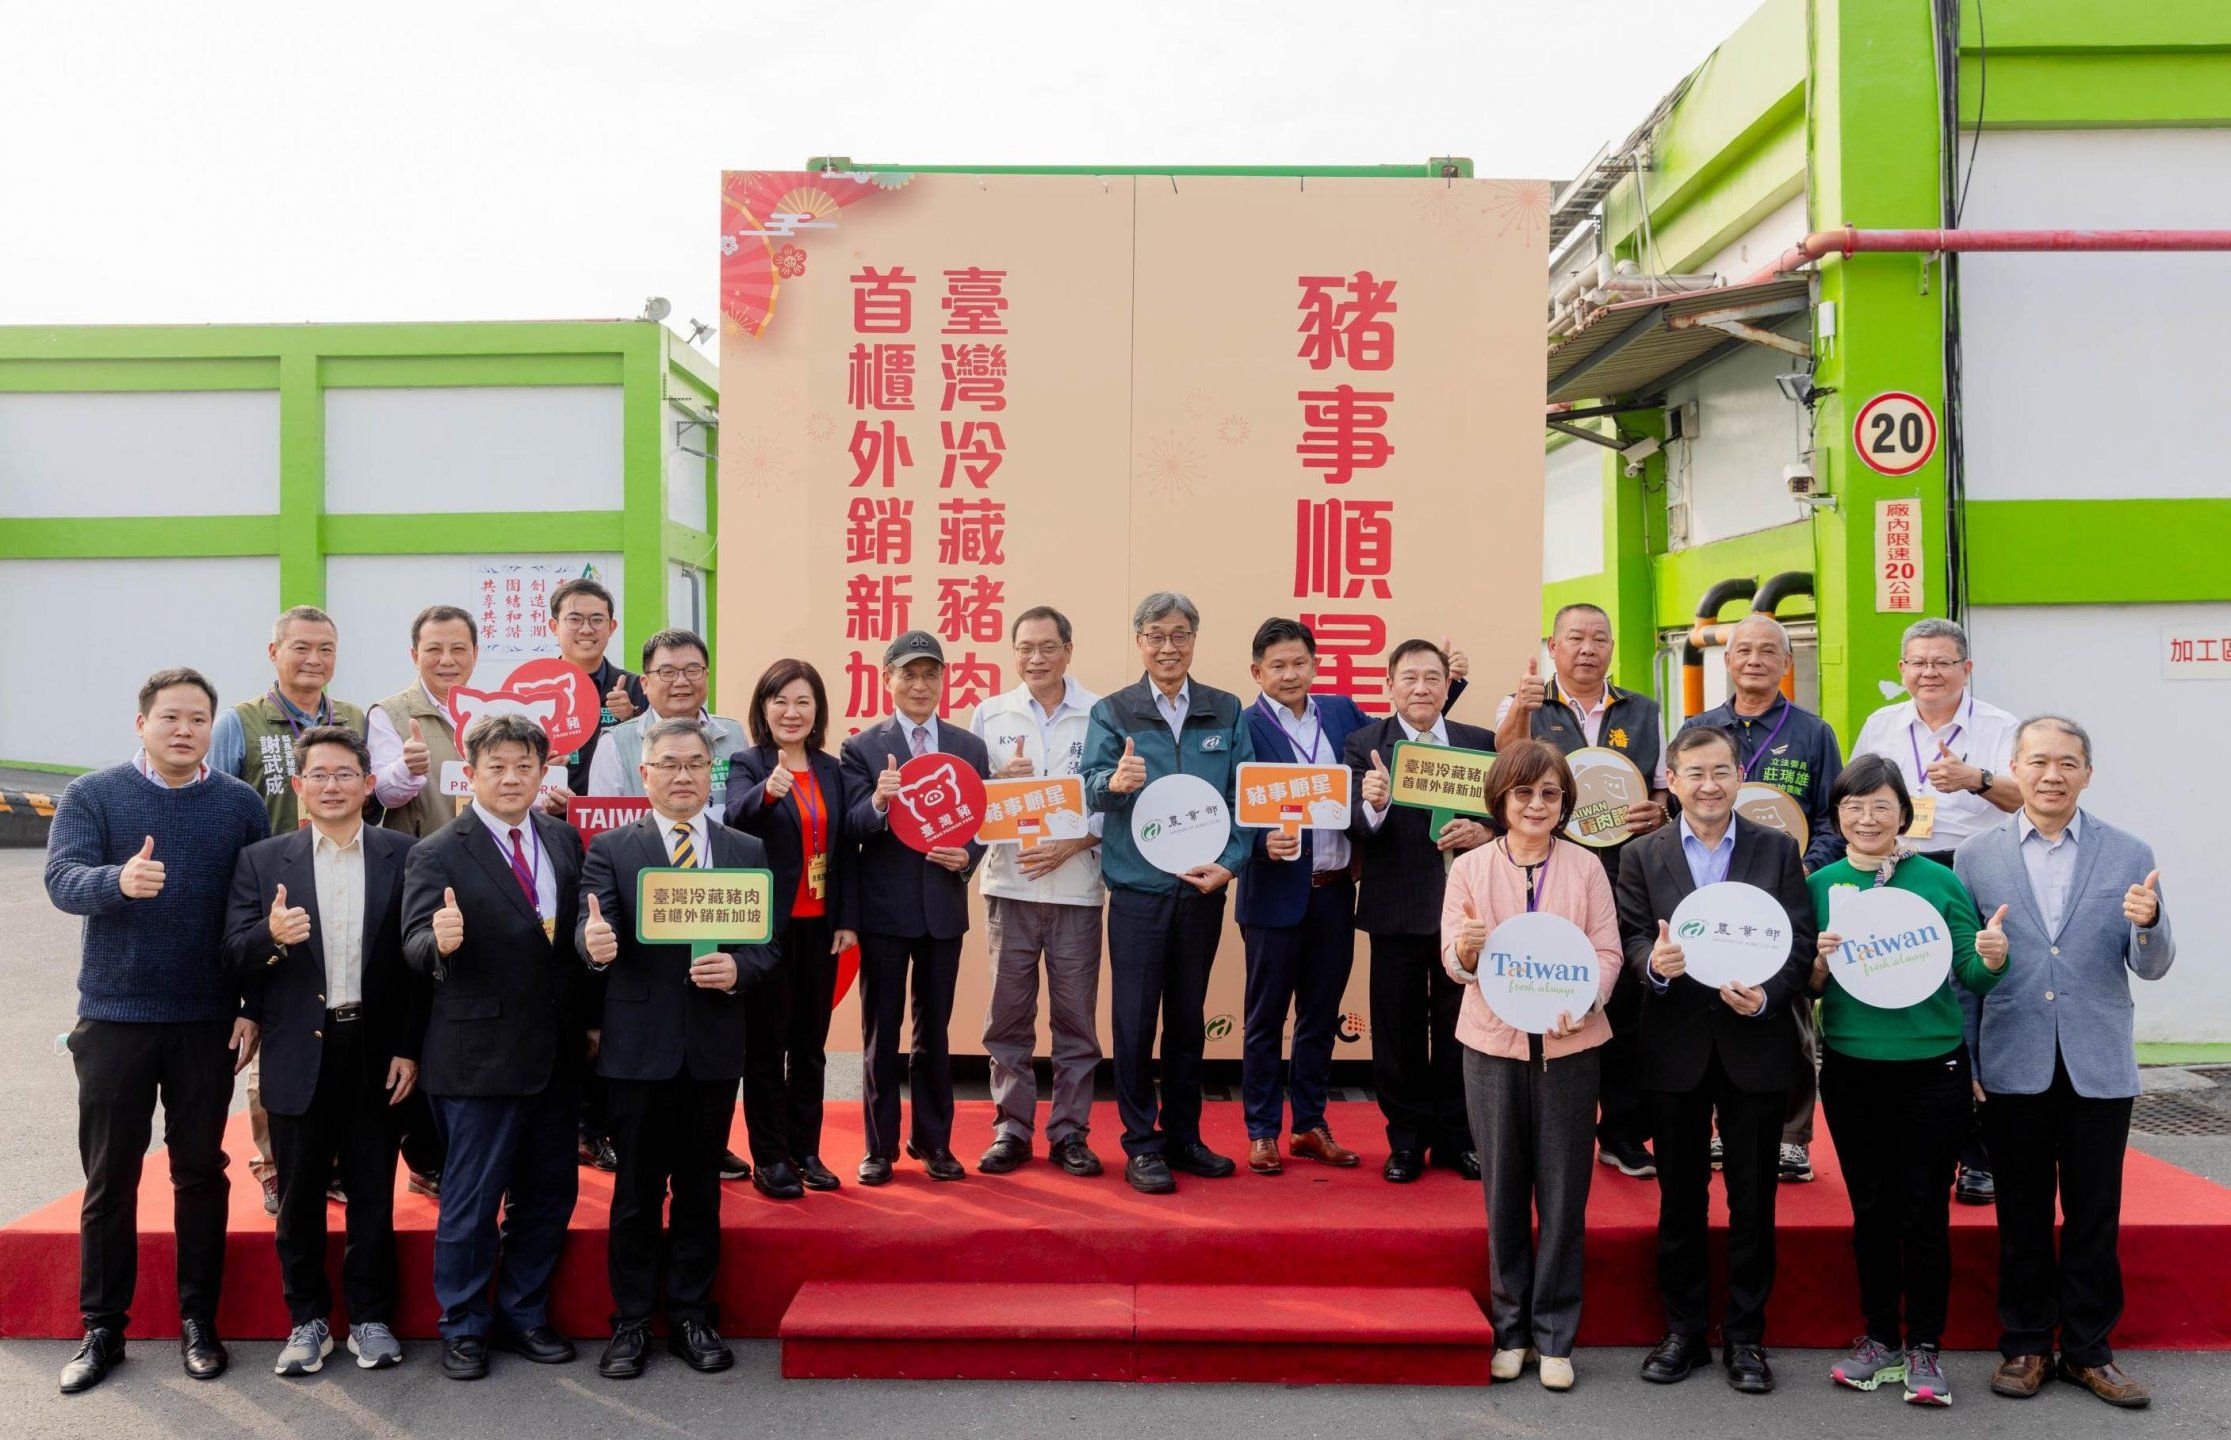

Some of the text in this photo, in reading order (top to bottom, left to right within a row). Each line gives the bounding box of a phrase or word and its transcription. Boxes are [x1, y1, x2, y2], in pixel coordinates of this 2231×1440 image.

[1871, 413, 1924, 454] 20
[845, 266, 916, 735] 首櫃外銷新加
[938, 266, 1008, 719] 臺灣冷藏豬肉
[1294, 269, 1398, 712] 豬事順星
[1885, 503, 1915, 609] 廠內限速20公里
[530, 579, 547, 638] 創造利潤
[260, 734, 284, 796] 謝武成
[1405, 759, 1487, 783] 臺灣冷藏豬
[1763, 767, 1810, 786] 莊瑞雄
[1770, 758, 1807, 770] 立法委員
[985, 784, 1067, 823] 豬事順星
[1245, 773, 1333, 807] 豬事順星
[1402, 776, 1486, 799] 首櫃外銷新加
[920, 804, 972, 838] 臺灣豬
[1571, 801, 1608, 821] AIWAN
[653, 888, 760, 905] 臺灣冷藏豬肉
[652, 908, 761, 923] 首櫃外銷新加坡
[1836, 925, 1940, 965] Taiwan
[1490, 952, 1590, 982] Taiwan
[1509, 980, 1534, 994] fresh
